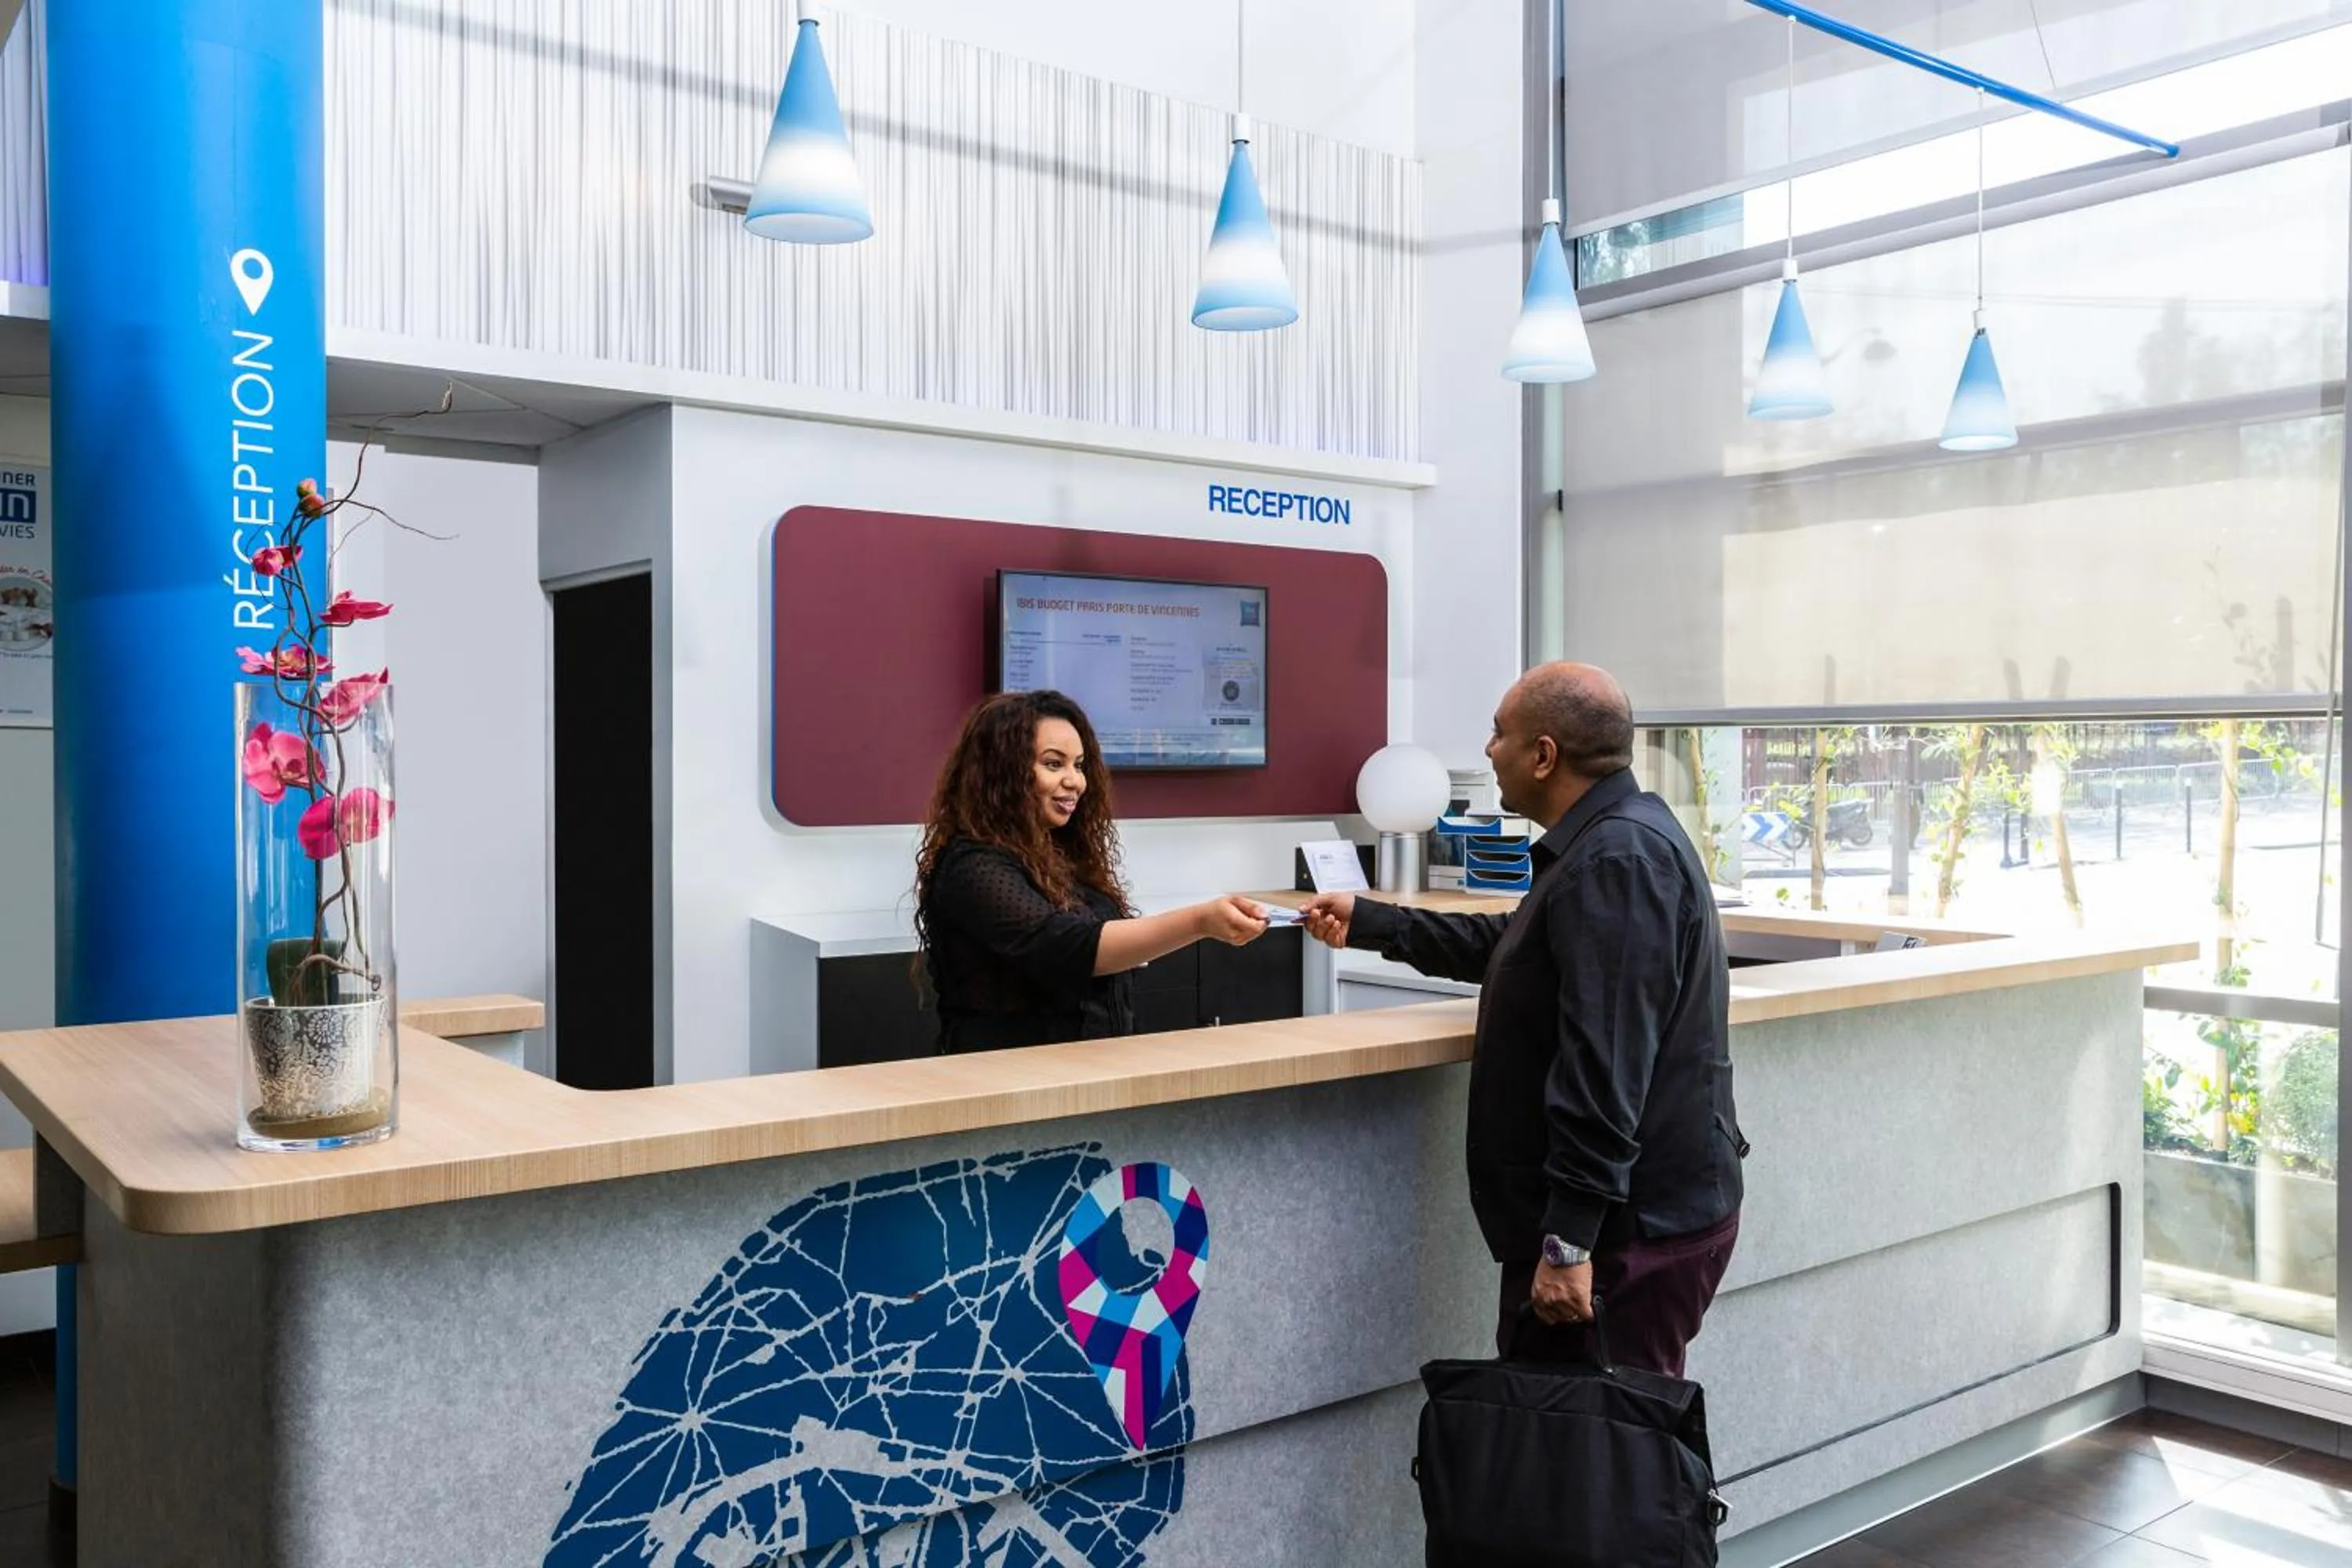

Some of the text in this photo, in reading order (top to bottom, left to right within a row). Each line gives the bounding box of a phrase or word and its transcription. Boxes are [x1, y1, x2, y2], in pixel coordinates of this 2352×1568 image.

[223, 330, 274, 629] RÉCEPTION
[1208, 485, 1350, 524] RECEPTION
[1037, 599, 1075, 612] BUDGET
[1077, 601, 1105, 612] PARIS
[1106, 602, 1136, 614] PORTE
[1138, 604, 1149, 615] DE
